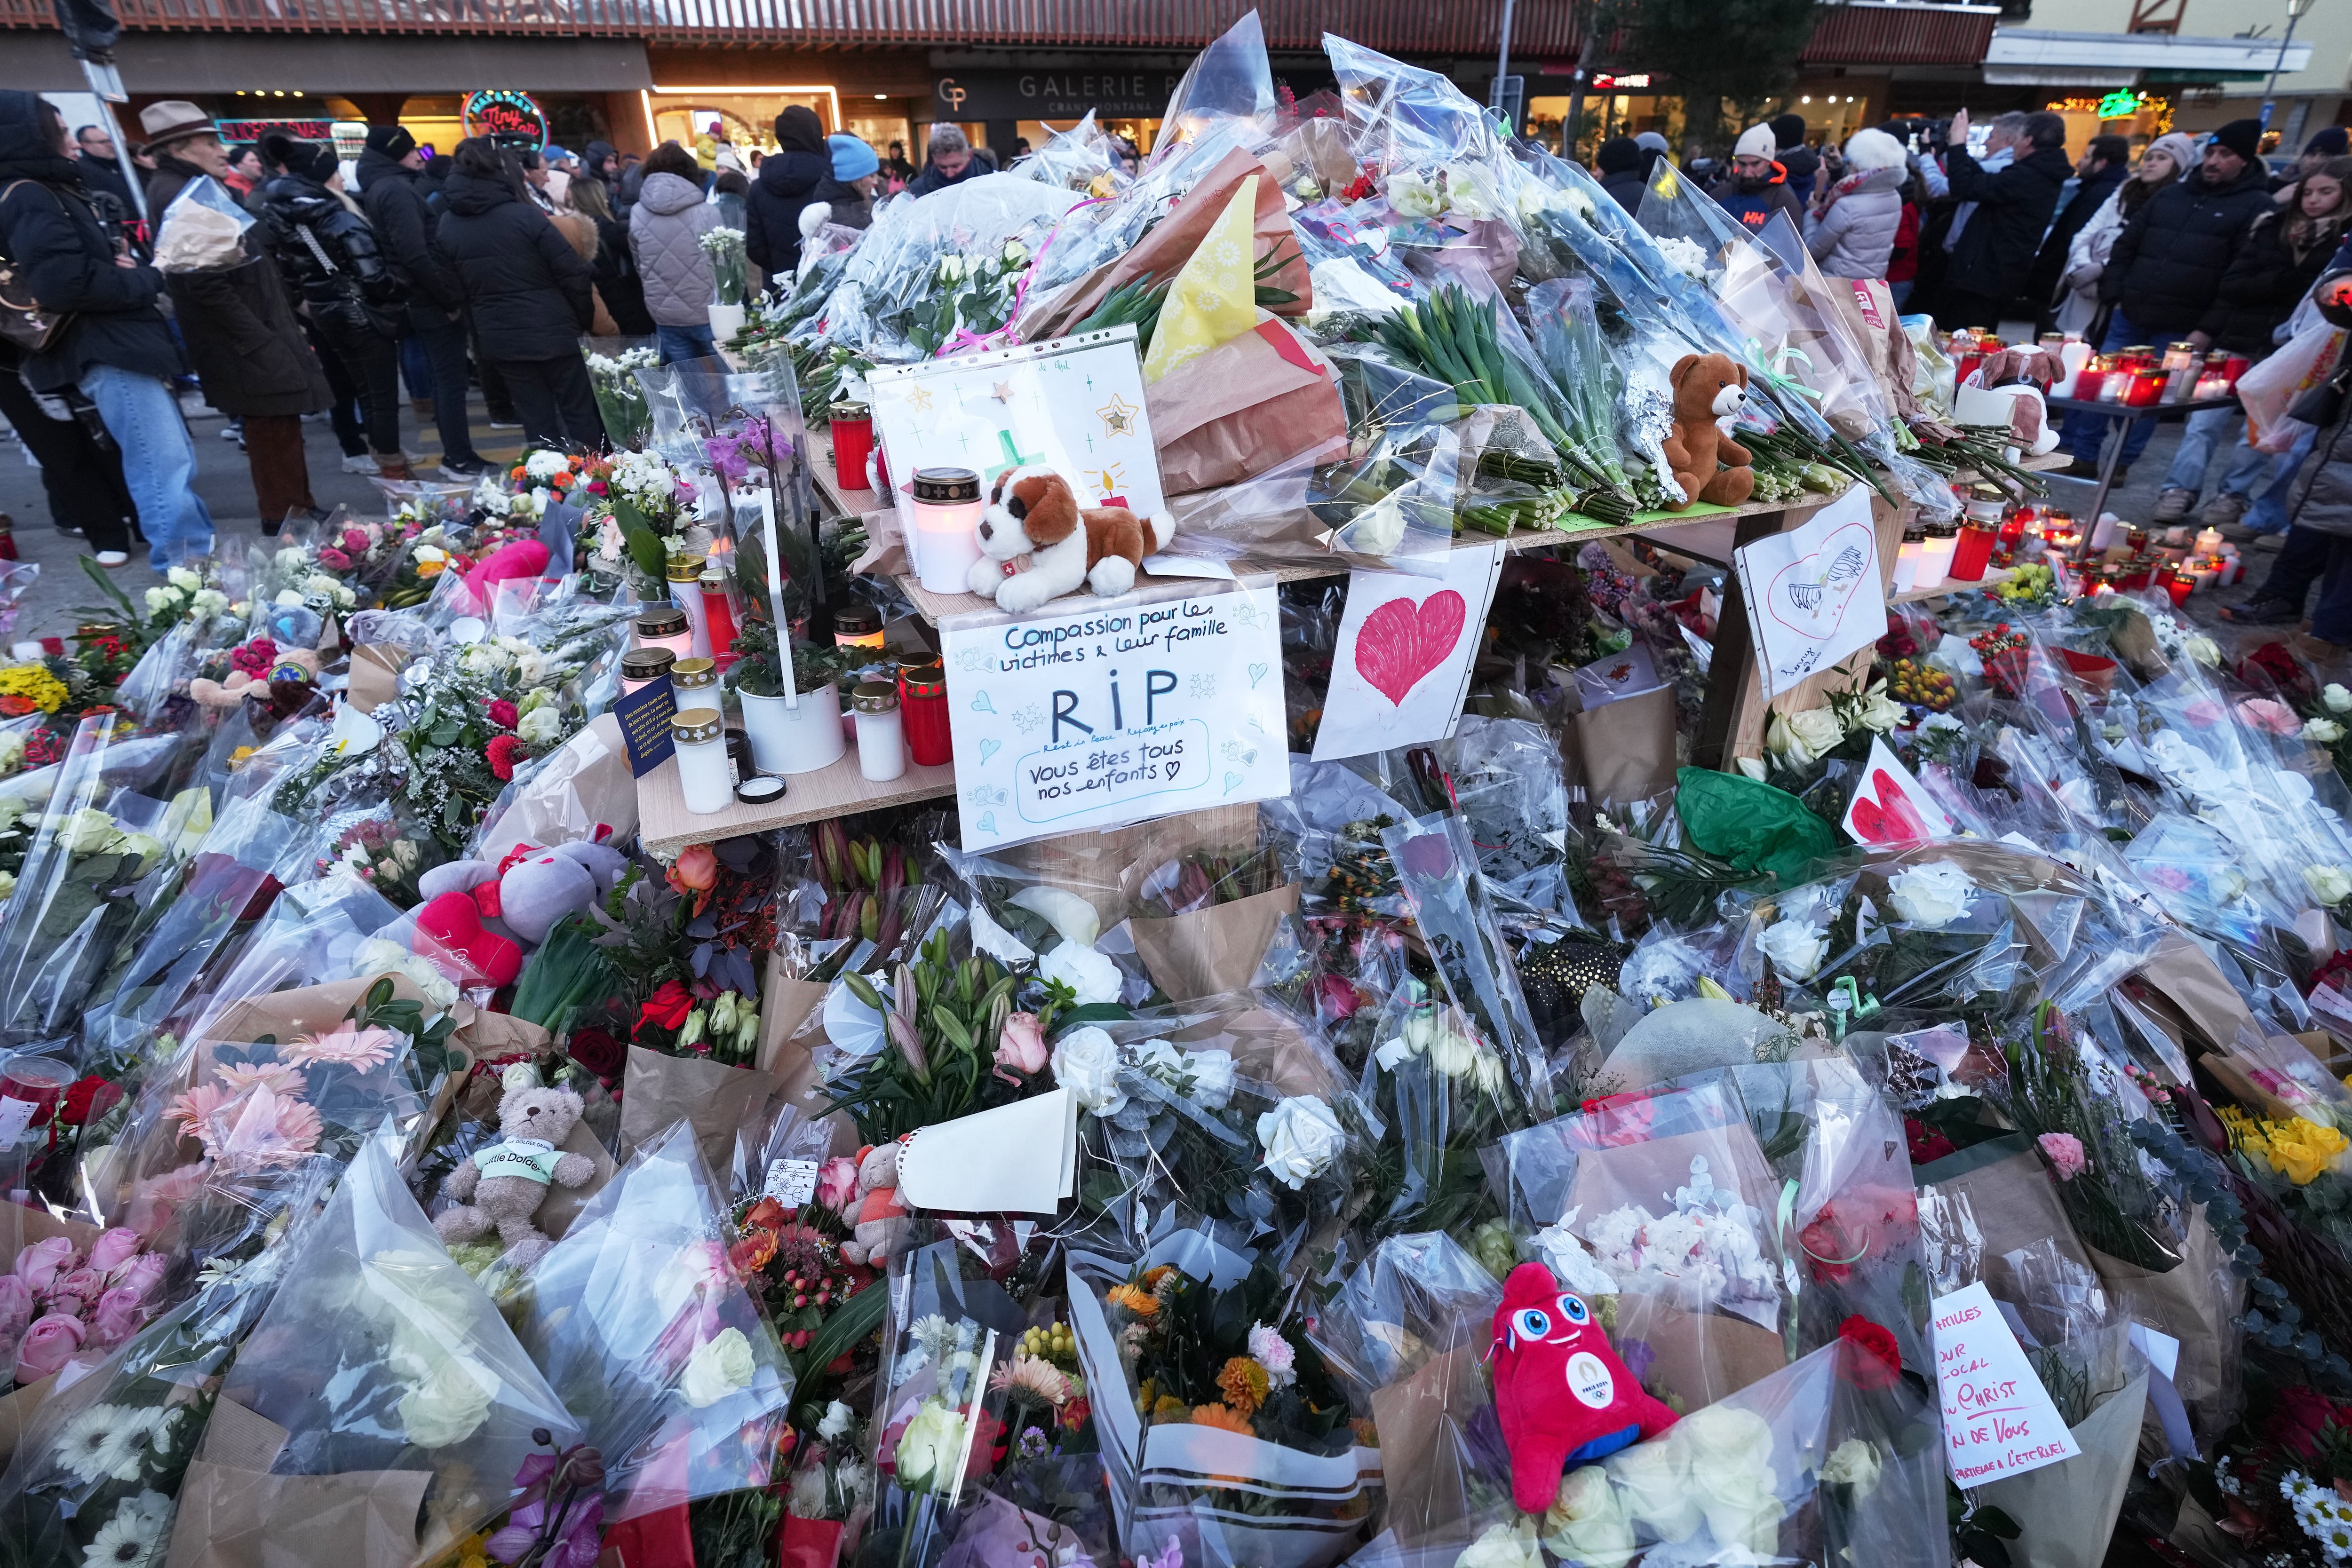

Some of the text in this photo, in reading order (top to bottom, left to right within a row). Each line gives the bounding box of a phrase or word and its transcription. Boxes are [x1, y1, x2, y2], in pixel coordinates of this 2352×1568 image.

[1019, 75, 1145, 97] GALERIE
[482, 105, 523, 127] Tiny
[1048, 101, 1152, 113] CRANS MONTANA
[1743, 211, 1765, 225] HH
[1005, 613, 1131, 655] Compassion
[1139, 607, 1177, 634] pour
[999, 647, 1085, 672] victimes
[1115, 634, 1160, 653] leur
[1164, 619, 1228, 653] famille
[632, 717, 641, 726] leurs
[641, 711, 651, 721] yeux.
[656, 702, 665, 711] mort
[633, 704, 648, 715] essuiera
[648, 698, 658, 706] toute
[657, 691, 668, 701] larme
[652, 728, 665, 740] existait
[1043, 740, 1072, 752] Rest
[1074, 737, 1085, 747] in
[1091, 735, 1115, 744] Peace
[1169, 718, 1185, 732] paix
[640, 747, 654, 759] disparu.
[1086, 750, 1130, 770] êtes
[1138, 739, 1184, 762] tous
[1037, 762, 1157, 800] nos enfants
[1353, 800, 1366, 818] fleuriot
[445, 948, 476, 971] Love
[536, 1143, 550, 1152] GRAND
[507, 1153, 541, 1172] Dolder
[1970, 1427, 1990, 1444] DE
